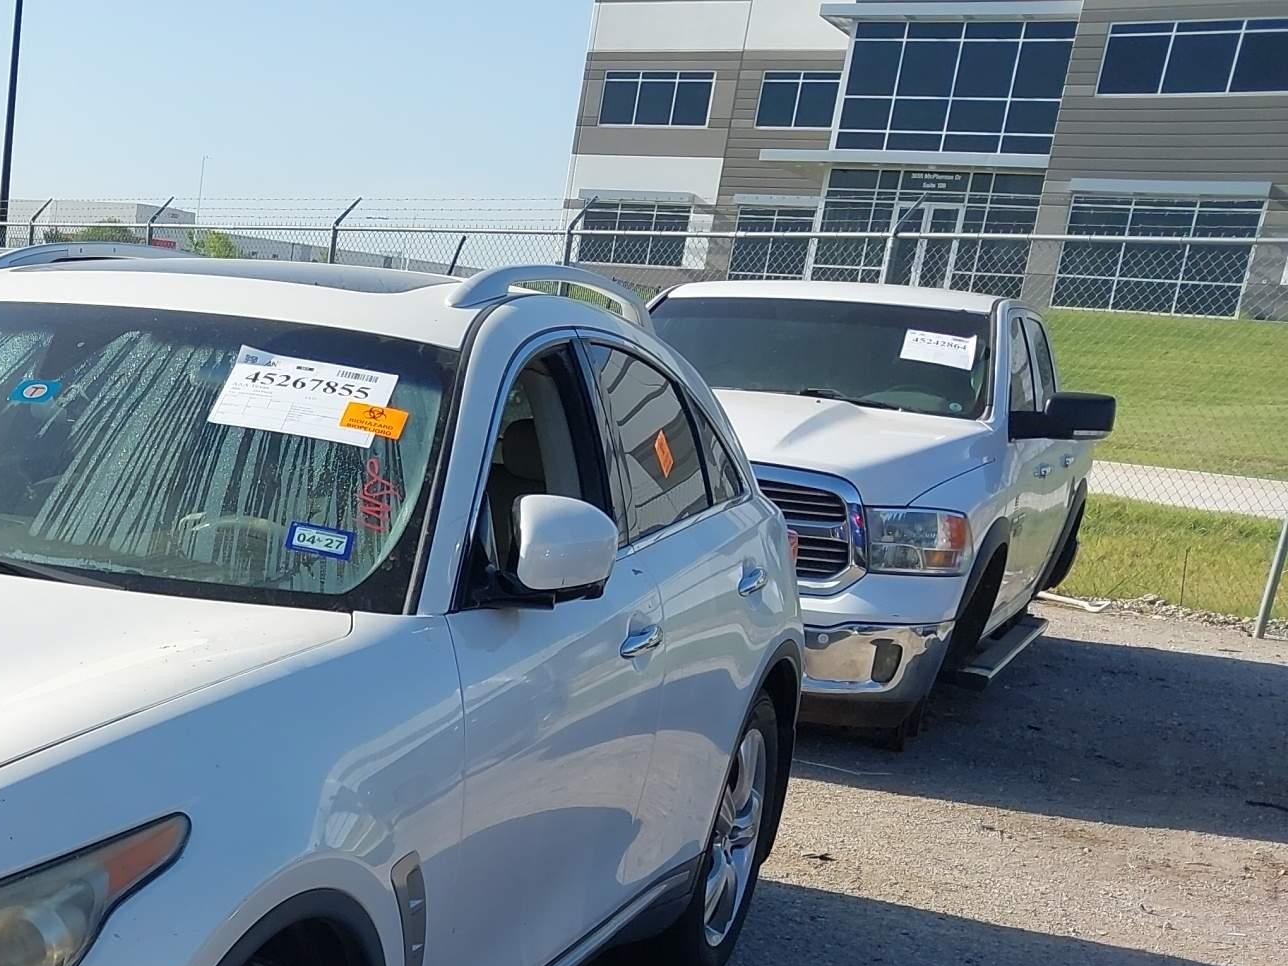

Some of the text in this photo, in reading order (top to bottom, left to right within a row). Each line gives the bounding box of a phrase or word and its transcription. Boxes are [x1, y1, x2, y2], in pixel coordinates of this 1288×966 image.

[245, 371, 372, 400] 45267855
[346, 422, 392, 436] BIOPELIGRO
[349, 417, 394, 430] BIOHAZARD
[297, 533, 345, 549] 04 27
